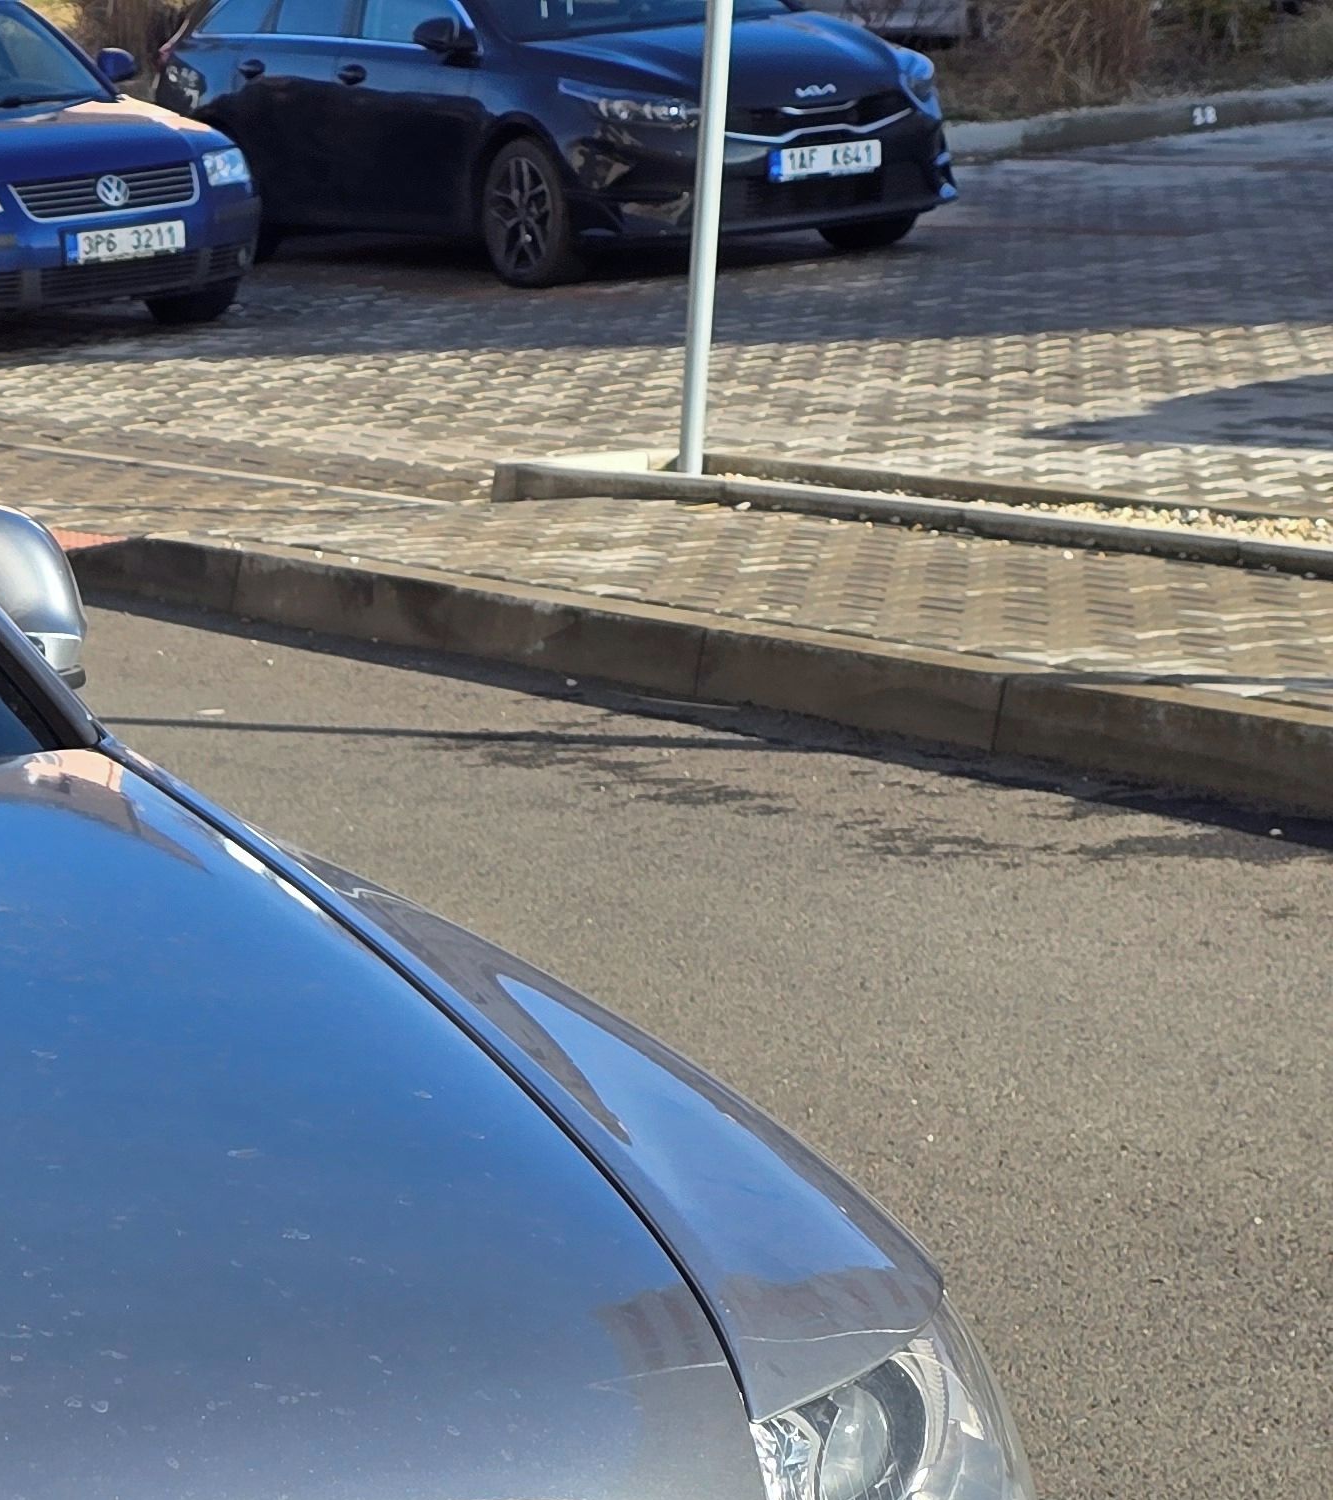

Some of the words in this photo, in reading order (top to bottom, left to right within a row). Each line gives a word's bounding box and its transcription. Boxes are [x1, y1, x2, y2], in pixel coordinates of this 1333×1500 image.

[789, 148, 817, 170] 1AF
[84, 232, 118, 256] 3P6
[132, 225, 176, 250] 3211
